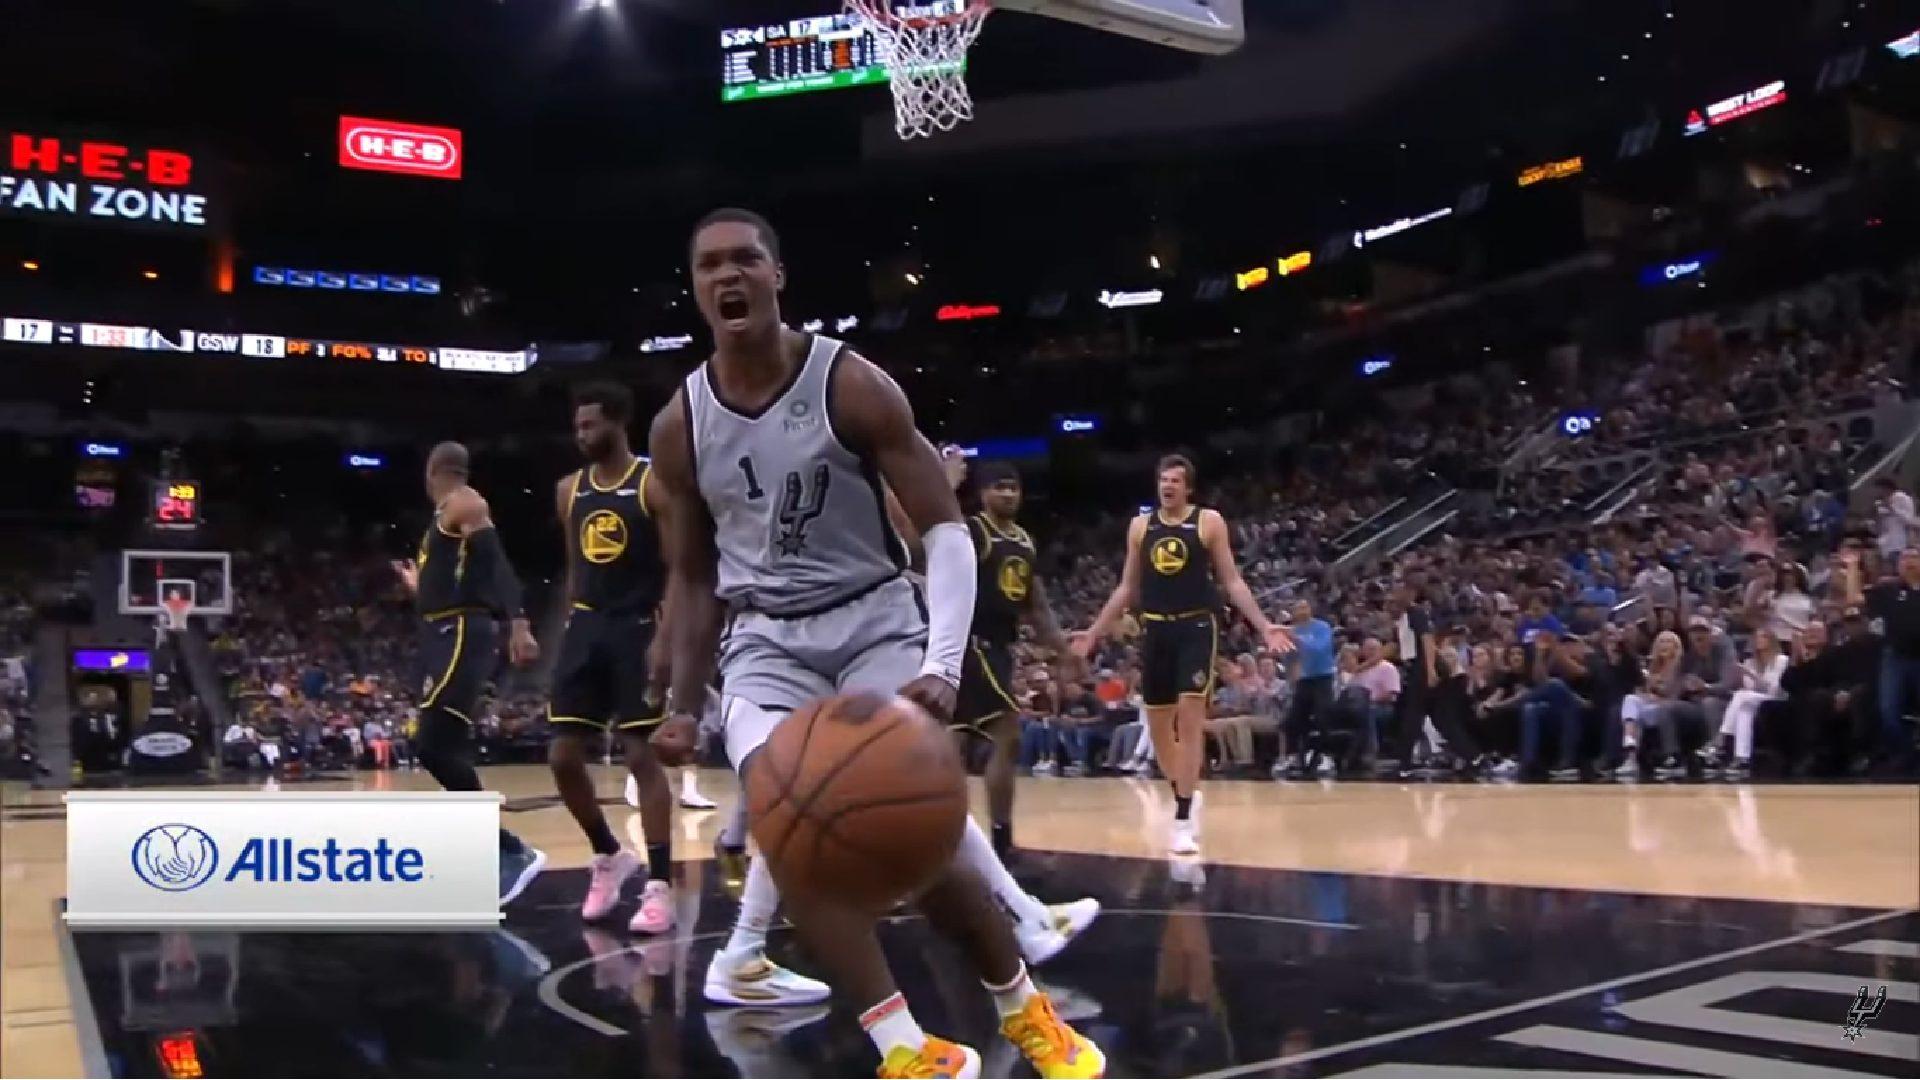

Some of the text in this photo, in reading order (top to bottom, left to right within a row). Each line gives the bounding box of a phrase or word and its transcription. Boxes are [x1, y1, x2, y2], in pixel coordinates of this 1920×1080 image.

[11, 134, 193, 186] H-E-B
[359, 134, 446, 162] H-E-B
[0, 176, 208, 225] FAN ZONE
[21, 323, 38, 339] 17
[198, 333, 239, 352] GSW
[256, 338, 274, 355] 18
[287, 340, 312, 355] PF
[402, 348, 427, 362] TO
[738, 456, 765, 500] 1
[160, 497, 192, 519] 24
